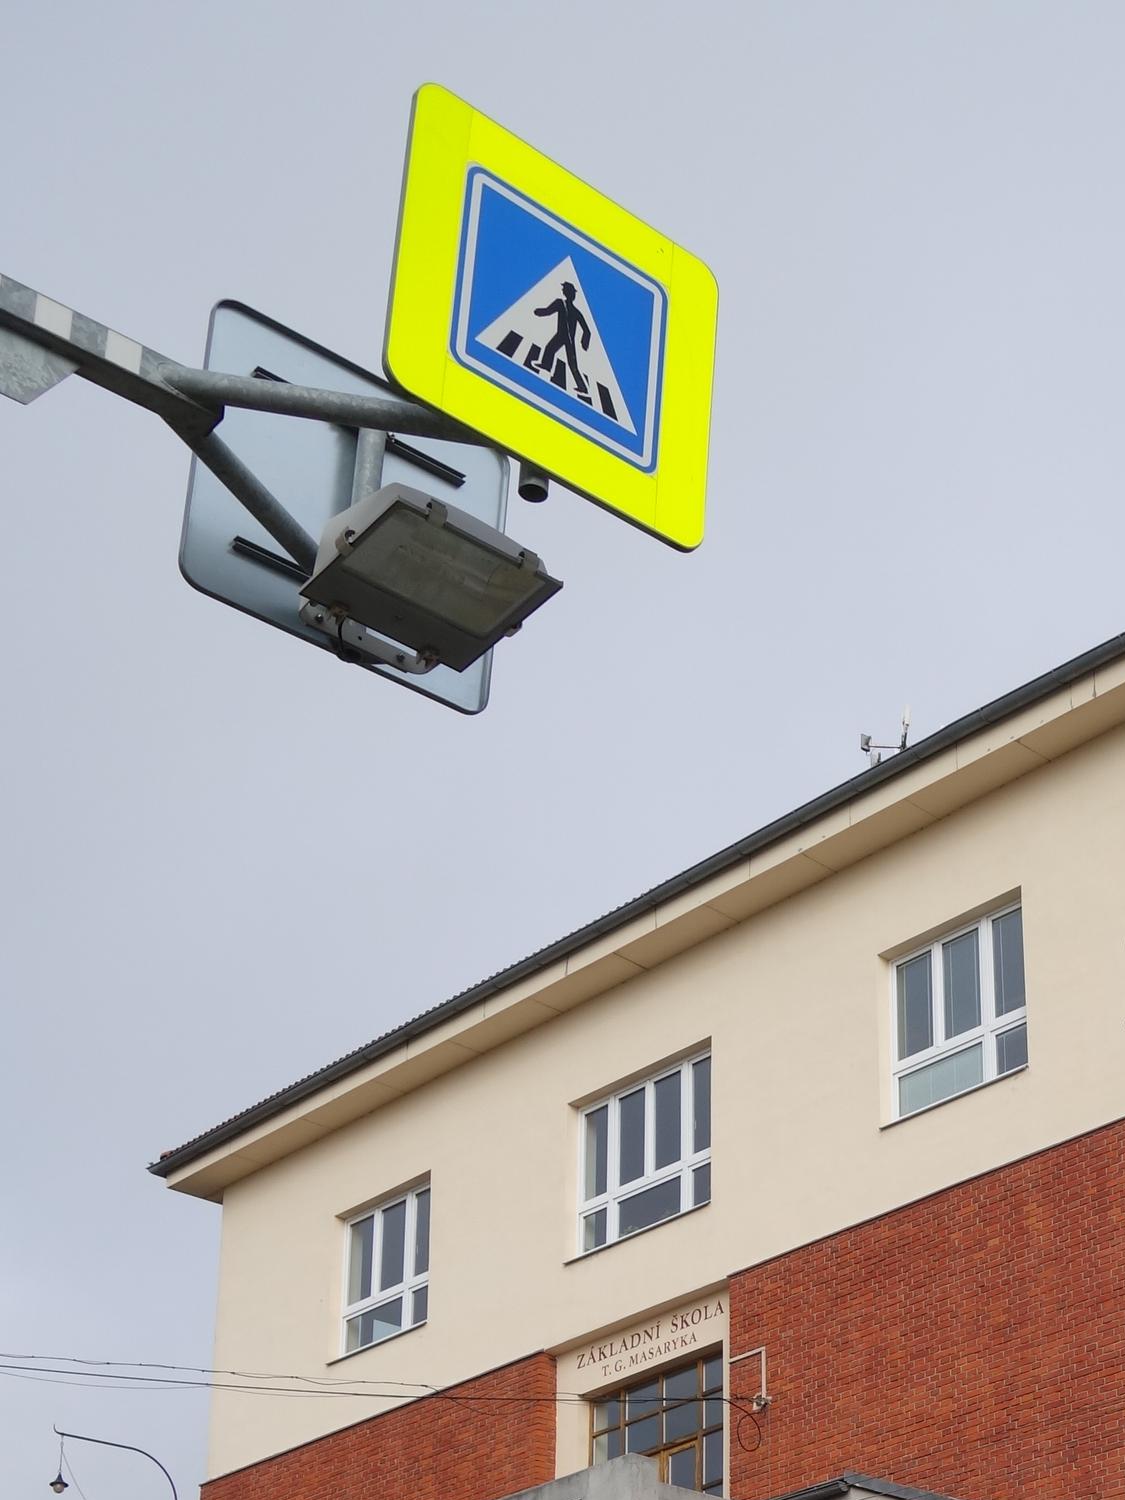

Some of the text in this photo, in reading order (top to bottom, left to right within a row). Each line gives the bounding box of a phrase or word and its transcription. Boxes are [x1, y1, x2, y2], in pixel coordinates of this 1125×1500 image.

[576, 1300, 725, 1369] ZÁKLADNÍ ŠKOLA
[602, 1332, 698, 1377] T. G. MASARYKA
